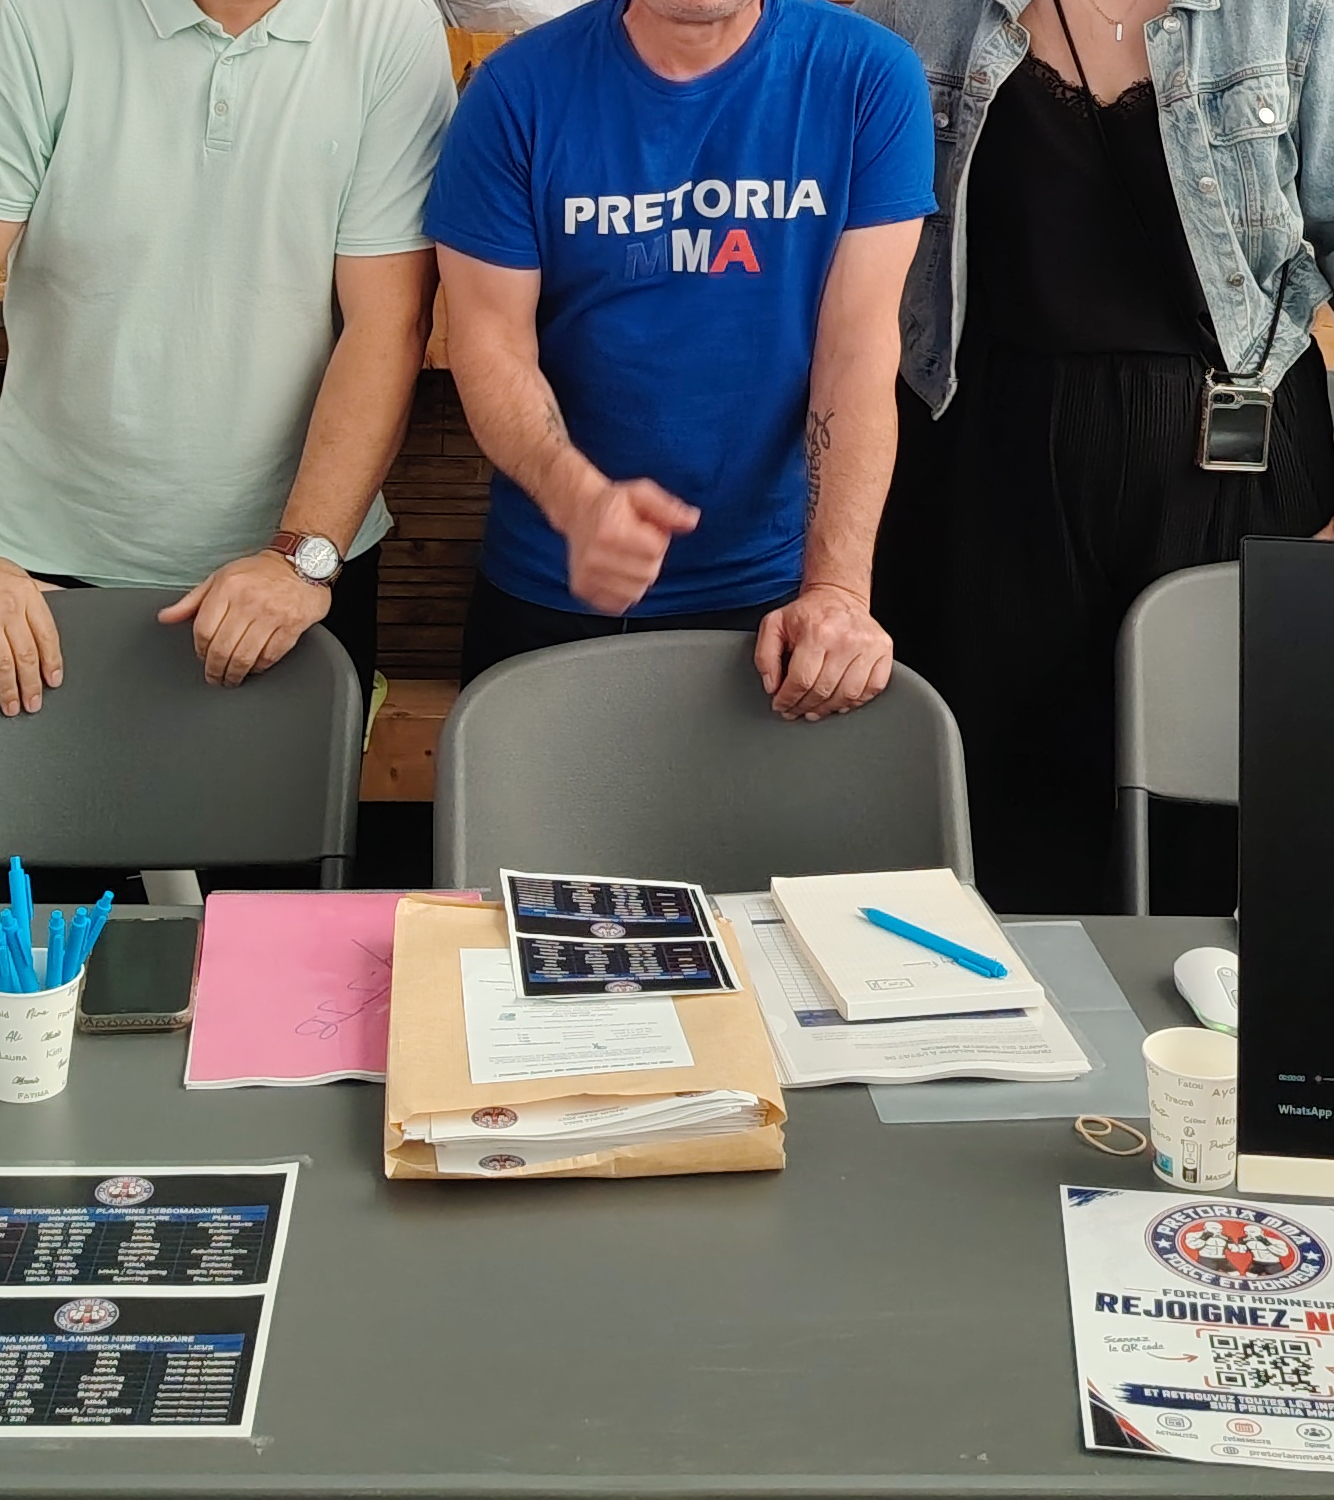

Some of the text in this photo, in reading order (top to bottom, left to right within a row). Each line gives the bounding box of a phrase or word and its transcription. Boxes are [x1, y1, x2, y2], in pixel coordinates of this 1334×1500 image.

[565, 179, 826, 234] PRETORIA
[625, 228, 761, 280] MMA
[1278, 1104, 1332, 1119] WhatsApp
[1157, 1206, 1312, 1244] PRETORIA MMA
[1163, 1253, 1320, 1291] FORCE ET HONNEUR
[1162, 1288, 1223, 1302] FORCE
[1226, 1294, 1245, 1304] ET
[1143, 1388, 1159, 1397] ET
[1162, 1389, 1235, 1403] RETROUVEZ
[1237, 1395, 1286, 1407] TOUTES
[1288, 1398, 1312, 1409] LES
[1209, 1402, 1237, 1411] SUR
[1239, 1403, 1303, 1416] PRETORIA
